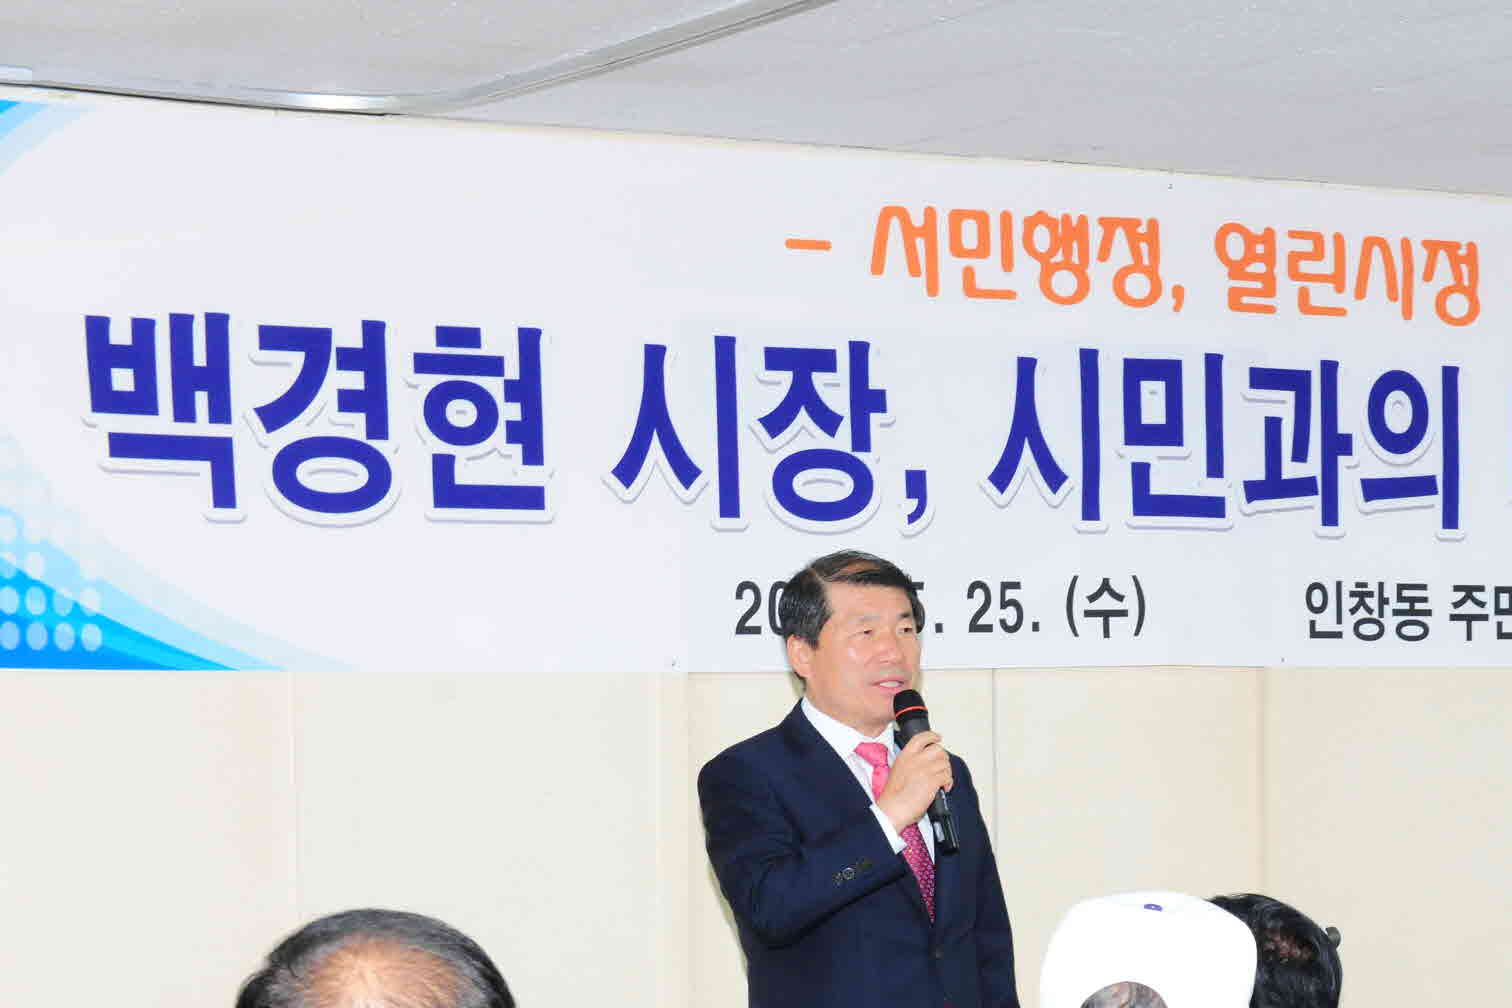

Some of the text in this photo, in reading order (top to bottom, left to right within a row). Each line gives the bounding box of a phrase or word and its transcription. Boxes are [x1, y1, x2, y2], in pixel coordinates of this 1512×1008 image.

[870, 205, 1185, 312] 서민행정,
[1214, 222, 1481, 327] 열린시정
[85, 312, 545, 514] 백경현
[611, 336, 927, 525] 시장,
[987, 348, 1460, 530] 시민과의
[967, 580, 1041, 634] 25.
[1066, 575, 1147, 638] (수)
[1305, 580, 1433, 641] 인창동
